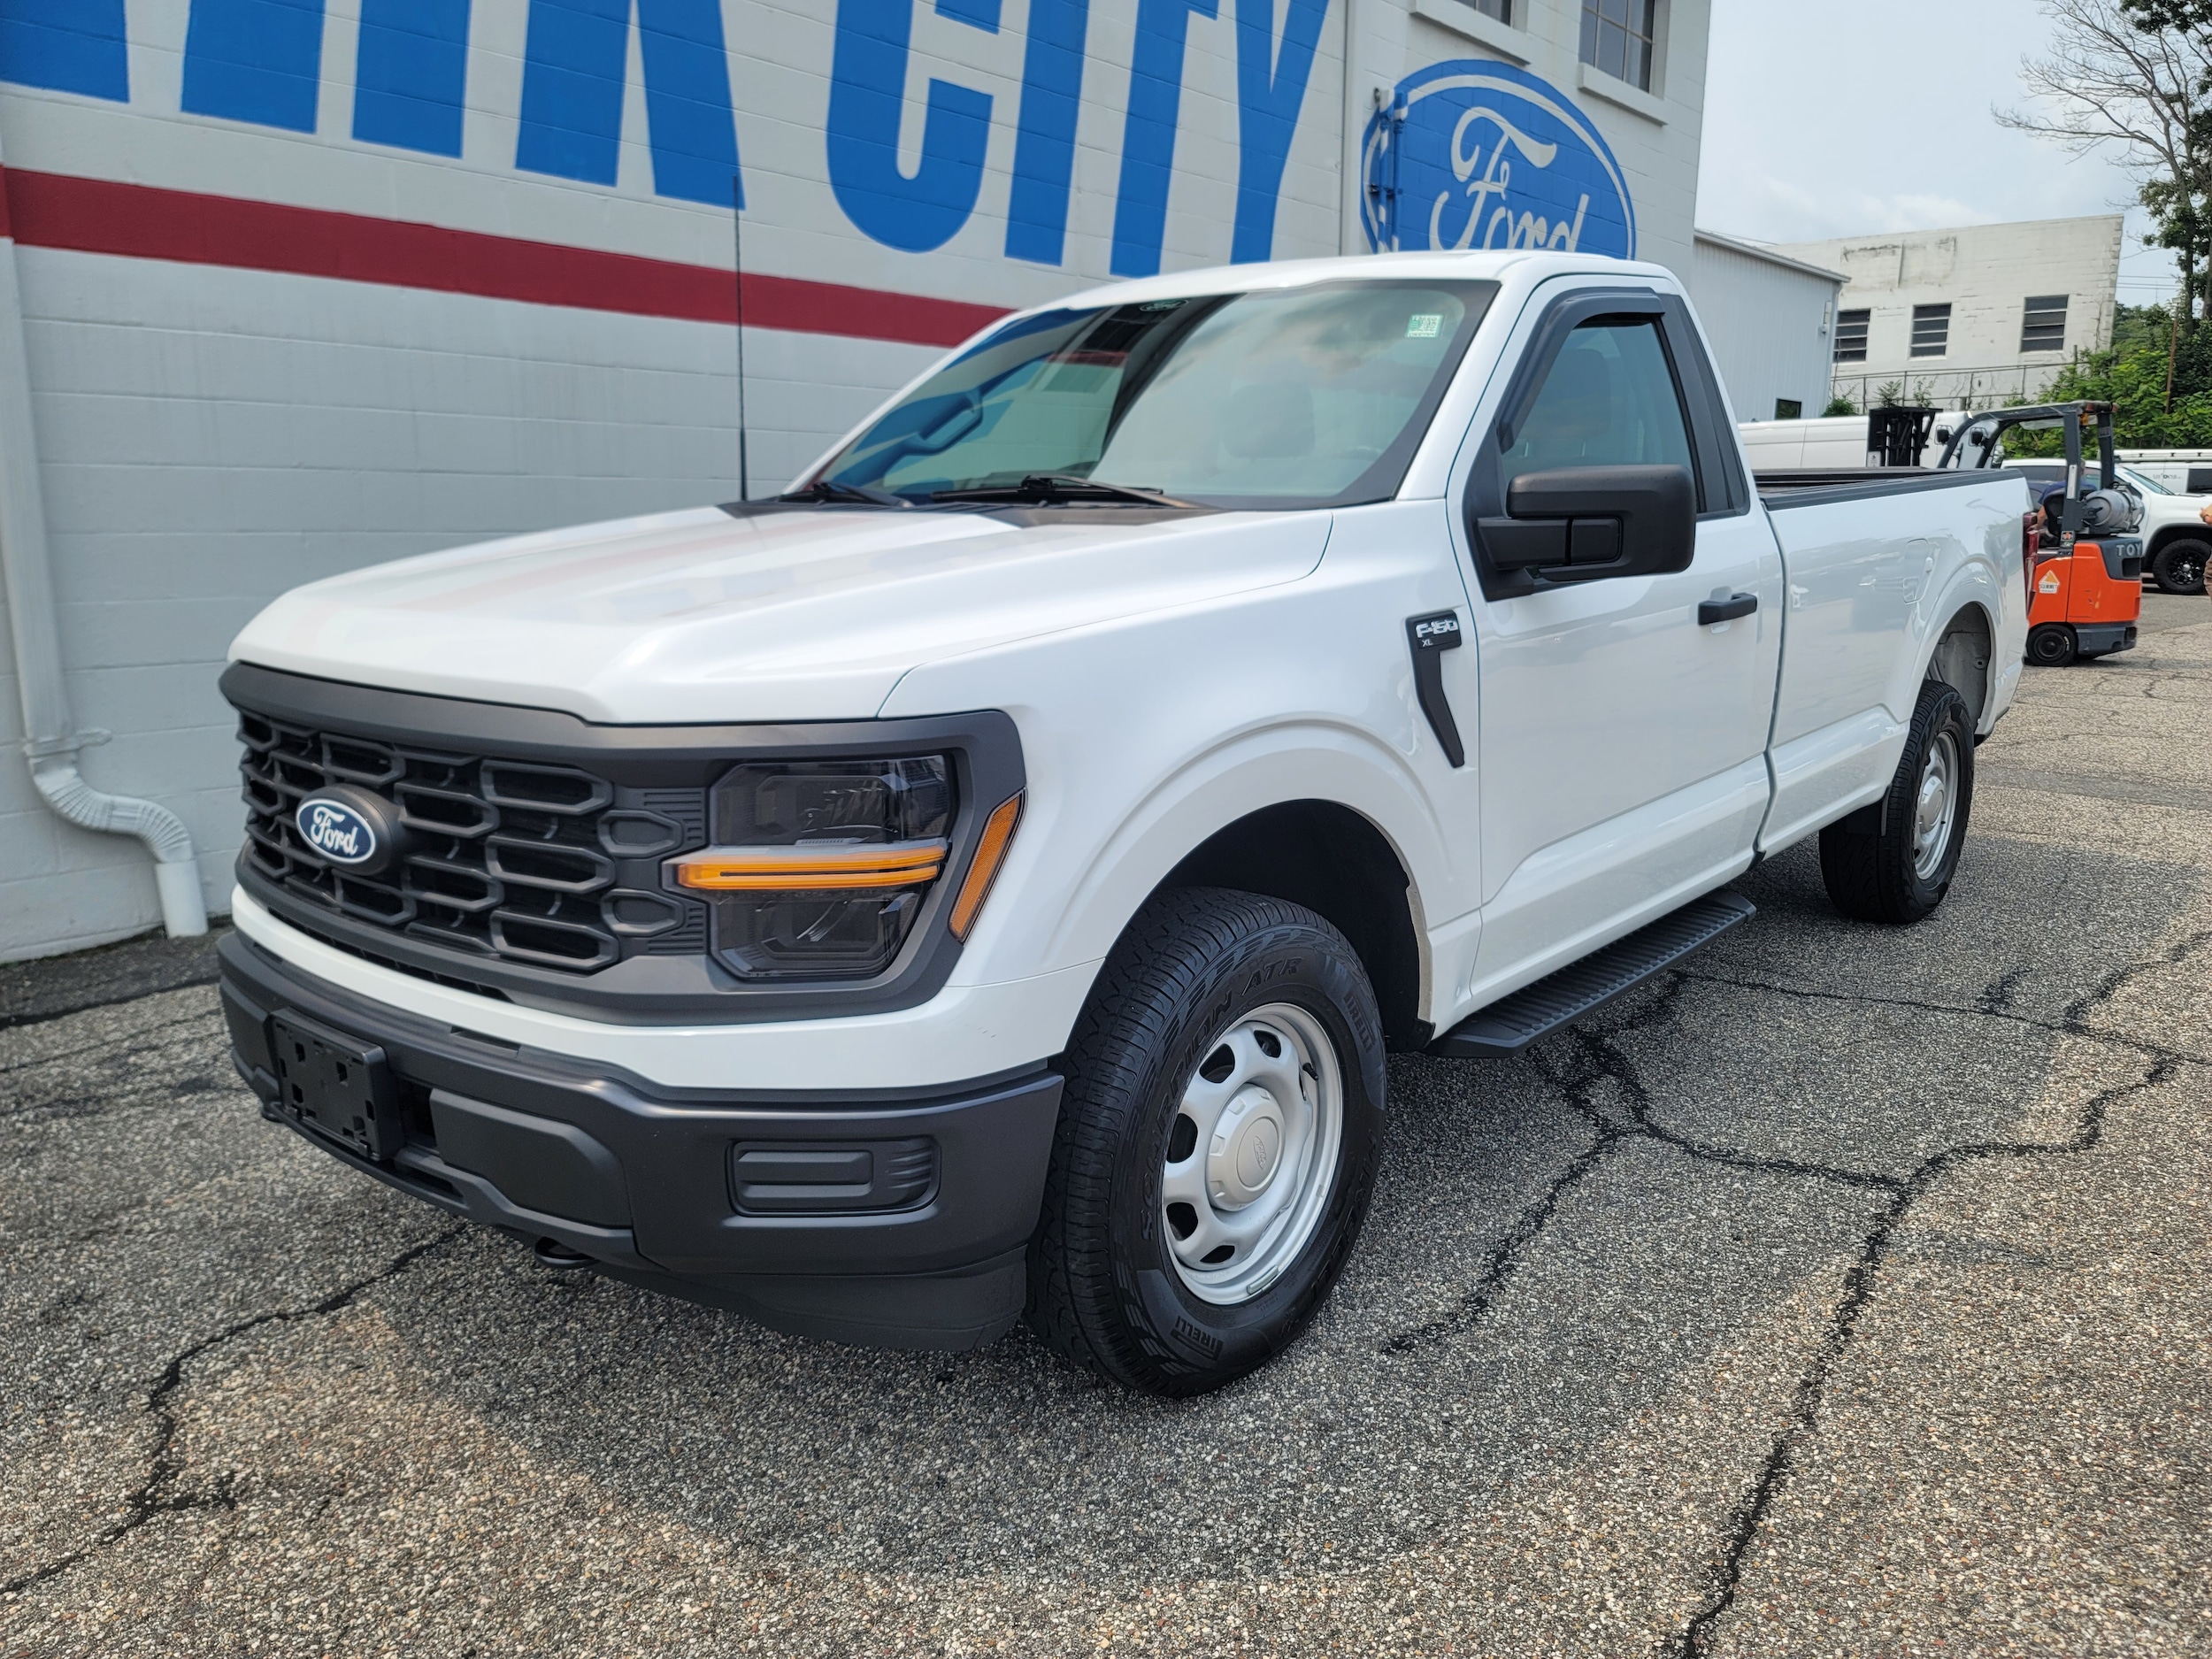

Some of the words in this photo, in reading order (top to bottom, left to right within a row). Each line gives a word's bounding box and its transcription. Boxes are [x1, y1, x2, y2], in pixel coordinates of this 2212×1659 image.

[826, 0, 1328, 277] CITY
[1429, 105, 1589, 251] Ford
[1416, 619, 1458, 638] F-150
[1421, 638, 1433, 647] XL
[310, 805, 359, 856] Ford
[1241, 956, 1303, 997] ATR
[1342, 988, 1376, 1054] PIRELLI
[1170, 1315, 1225, 1361] PIRELLI
